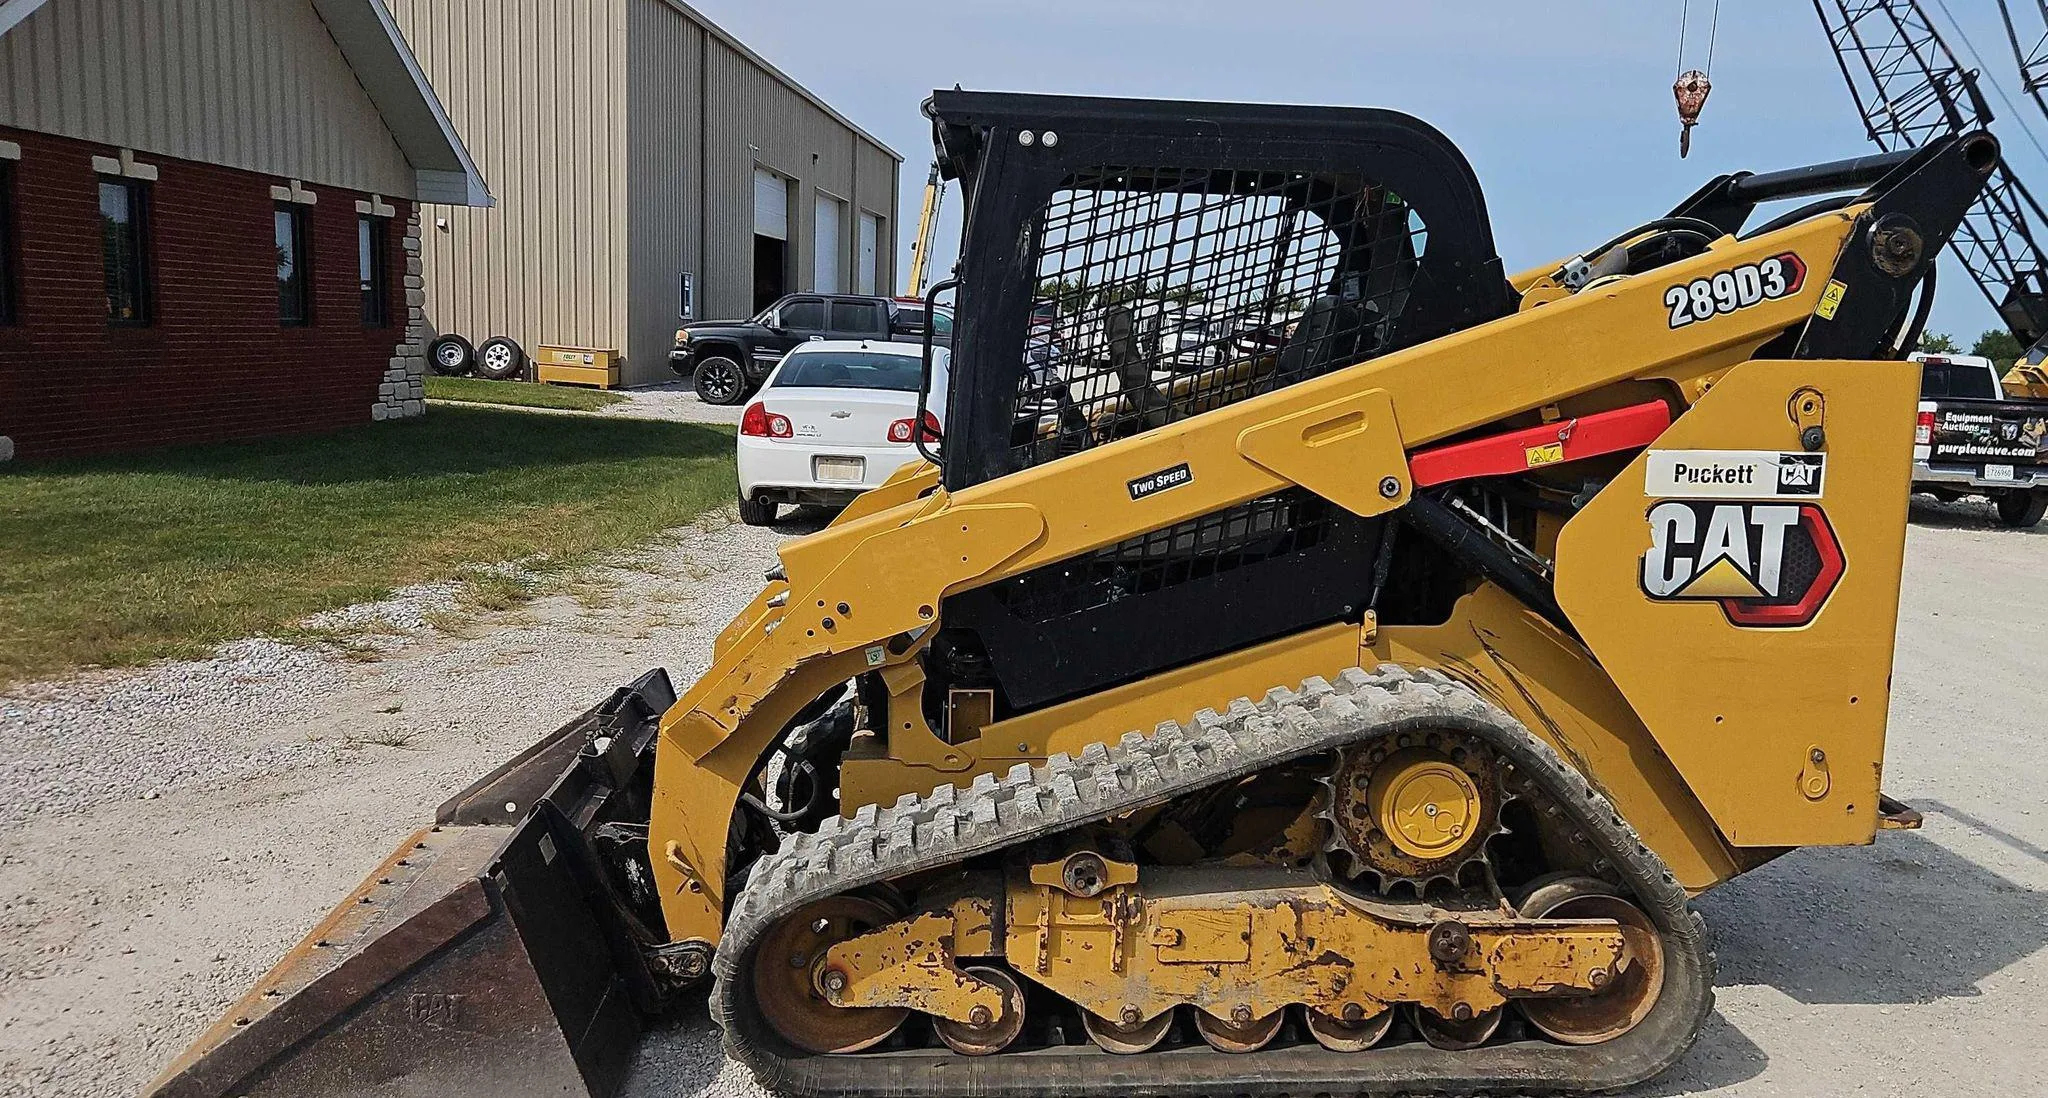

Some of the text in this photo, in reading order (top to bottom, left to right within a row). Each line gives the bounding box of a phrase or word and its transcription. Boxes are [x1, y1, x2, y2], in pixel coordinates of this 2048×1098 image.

[1666, 258, 1786, 327] 289D3
[1945, 411, 1993, 423] Equipment
[1942, 421, 1980, 432] Auctions
[1937, 443, 2036, 457] purplewave.com
[1674, 463, 1822, 486] Puckett CAT
[1644, 503, 1799, 597] CAT
